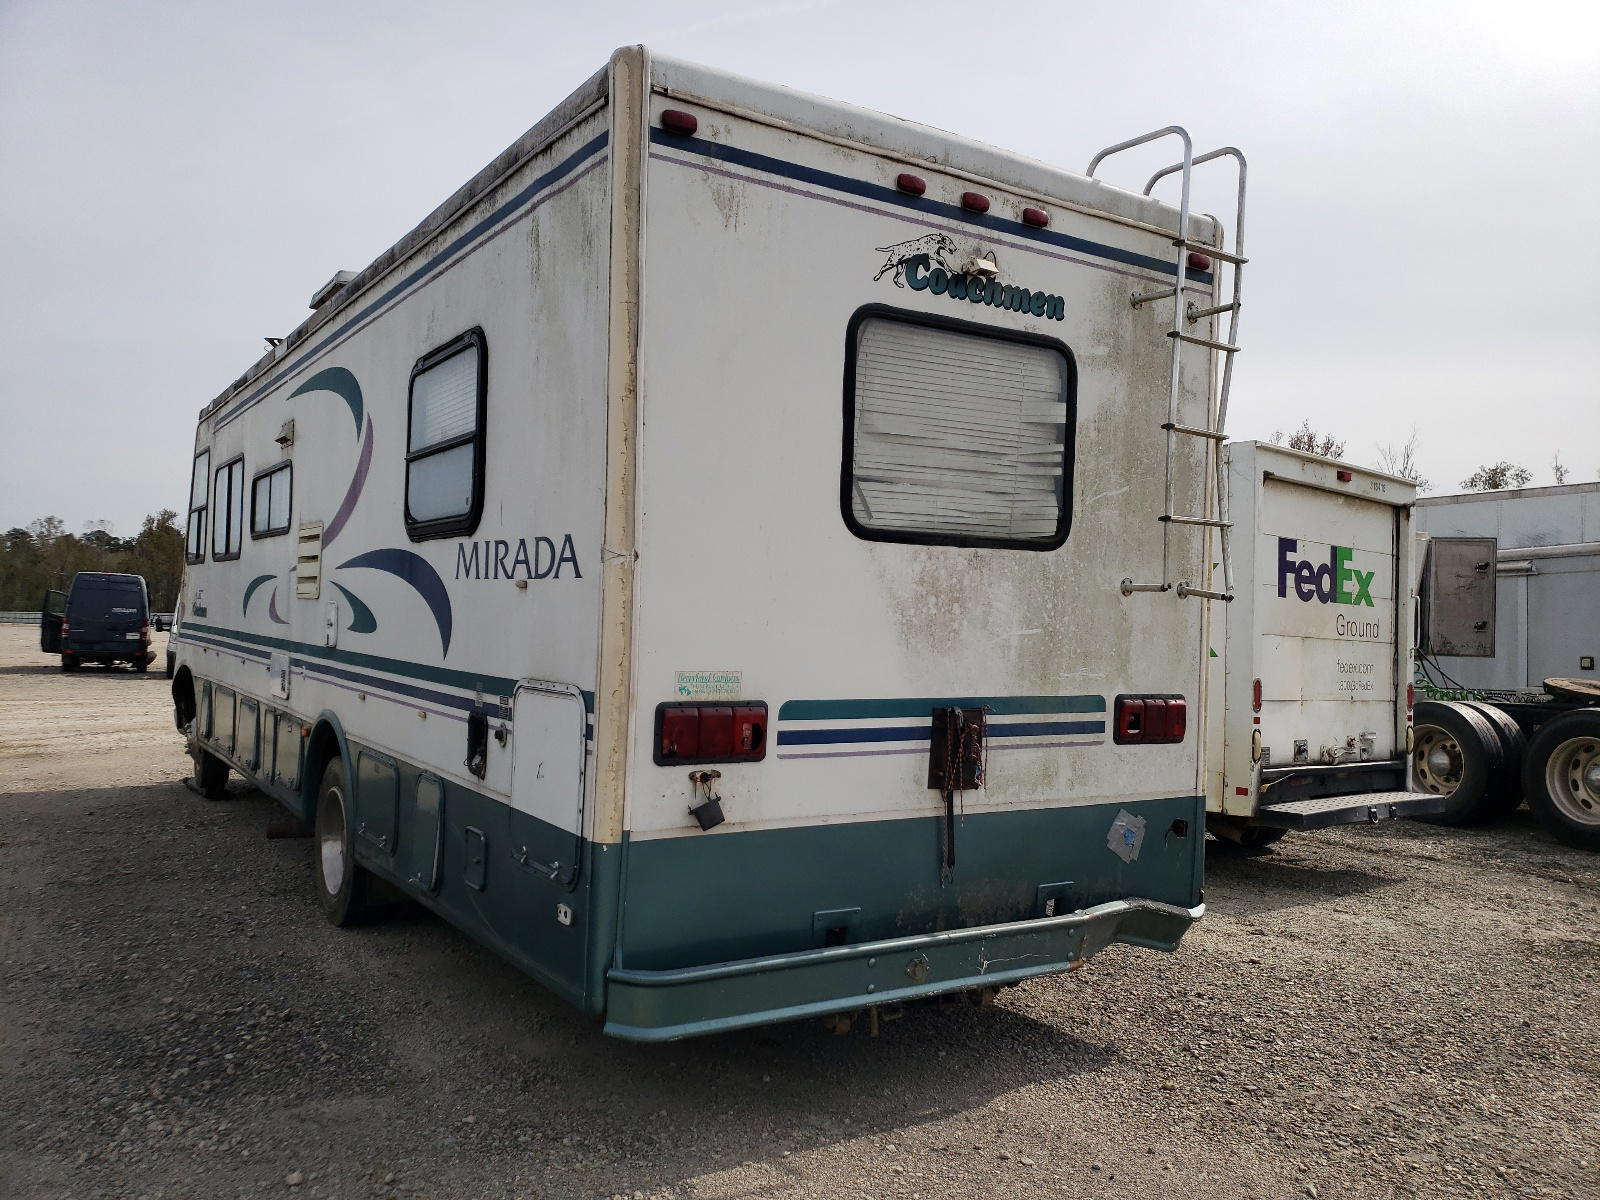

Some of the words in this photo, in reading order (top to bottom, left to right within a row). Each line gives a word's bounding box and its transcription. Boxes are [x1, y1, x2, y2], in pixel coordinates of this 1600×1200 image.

[904, 252, 1065, 321] Coachmen
[455, 533, 583, 580] MIRADA
[1277, 536, 1376, 608] FedEx
[1336, 613, 1380, 639] Ground
